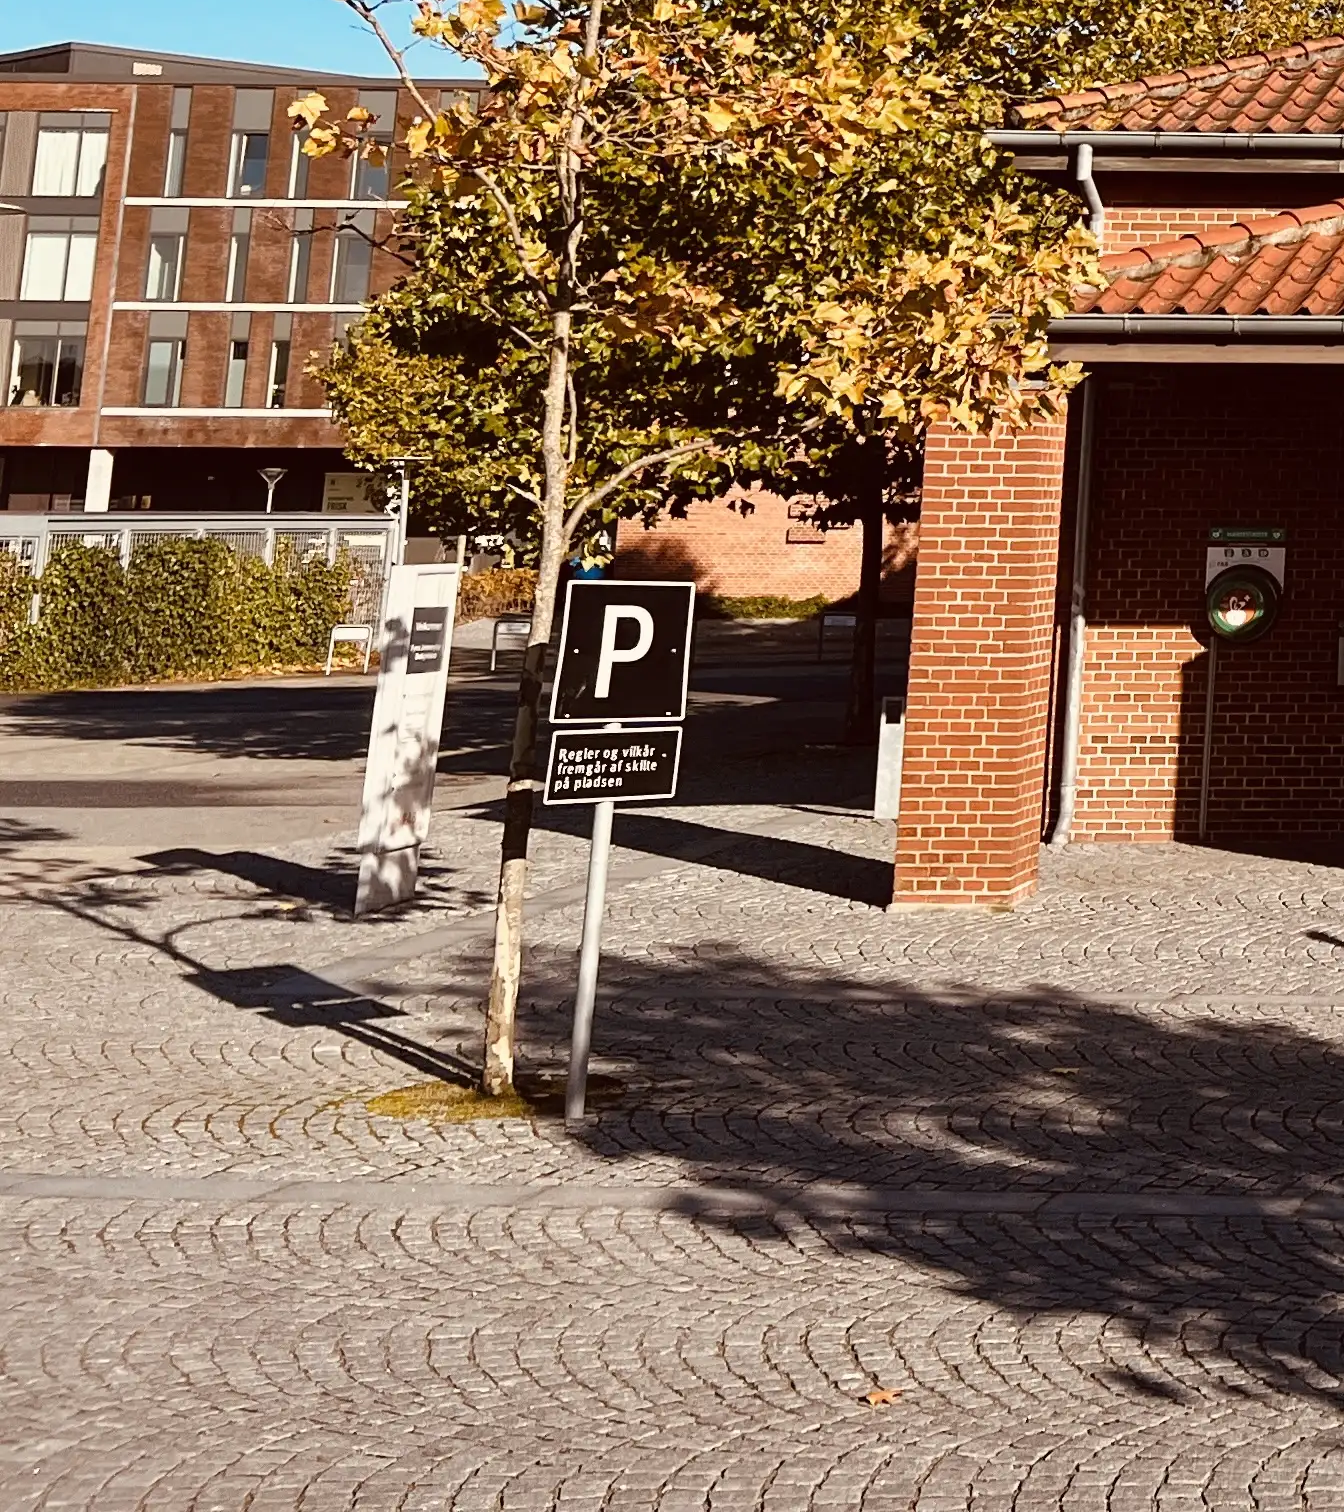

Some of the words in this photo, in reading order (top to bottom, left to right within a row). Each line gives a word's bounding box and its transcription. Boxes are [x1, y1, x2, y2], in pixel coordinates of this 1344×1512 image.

[594, 604, 654, 698] P
[558, 748, 600, 762] Regler
[602, 749, 619, 761] og
[622, 744, 656, 758] vilkår
[557, 761, 608, 777] fremgår
[609, 760, 624, 773] af
[624, 759, 658, 772] skilte
[553, 776, 570, 793] på
[573, 776, 623, 792] pladsen
